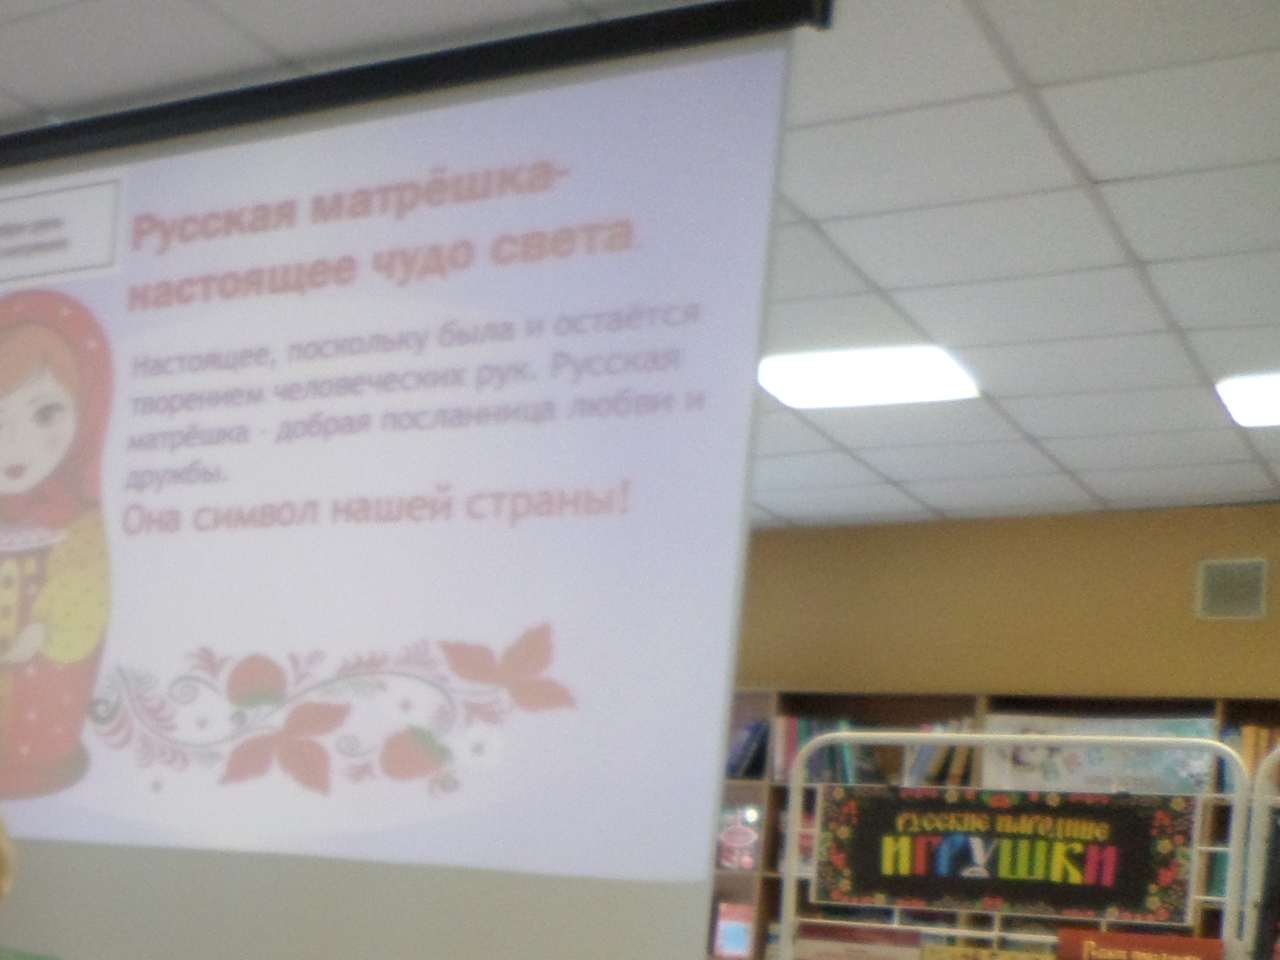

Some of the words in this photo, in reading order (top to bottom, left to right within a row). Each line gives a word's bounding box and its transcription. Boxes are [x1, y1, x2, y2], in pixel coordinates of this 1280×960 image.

[132, 200, 297, 254] Русская
[127, 254, 357, 311] настоящее
[372, 238, 475, 288] чудо
[490, 217, 634, 266] света
[132, 344, 277, 378] Настоящее,
[288, 327, 427, 363] поскольку
[438, 316, 515, 347] была
[526, 317, 544, 336] и
[554, 301, 701, 337] остаётся
[132, 382, 264, 419] творением
[274, 367, 466, 403] человеческих
[475, 363, 537, 393] рук.
[551, 347, 680, 381] Русская
[127, 421, 250, 453] матрёшка
[275, 411, 371, 444] добрая
[383, 401, 556, 432] посланница
[569, 391, 672, 419] любви
[685, 391, 705, 411] и
[122, 503, 180, 535] Она
[193, 499, 318, 530] символ
[331, 483, 454, 523] нашей
[466, 479, 631, 527] страны!
[125, 462, 228, 494] дружбы.
